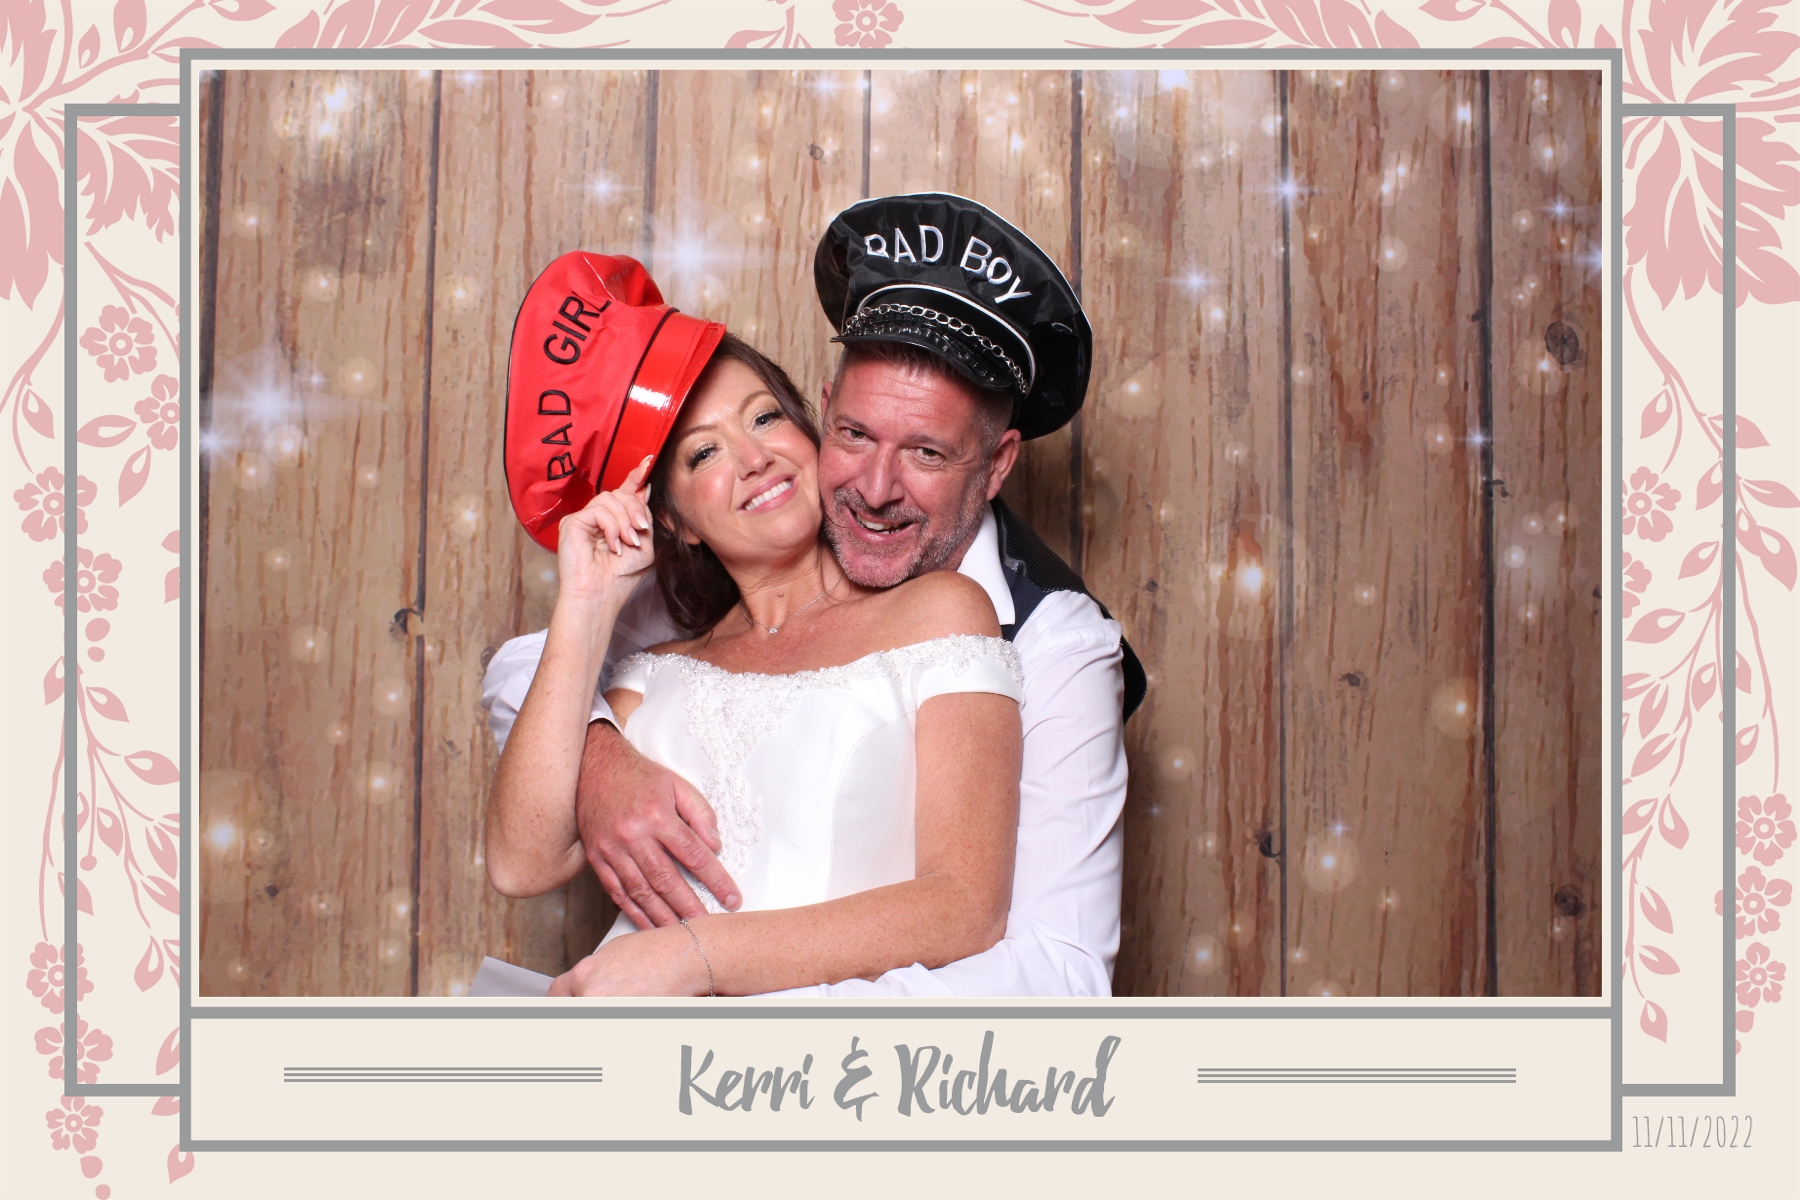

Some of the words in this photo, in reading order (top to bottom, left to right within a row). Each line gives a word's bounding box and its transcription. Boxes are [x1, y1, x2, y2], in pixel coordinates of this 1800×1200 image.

[864, 224, 944, 264] BAD
[960, 236, 1033, 304] BOY
[543, 290, 612, 365] GIRL
[538, 389, 577, 481] BAD
